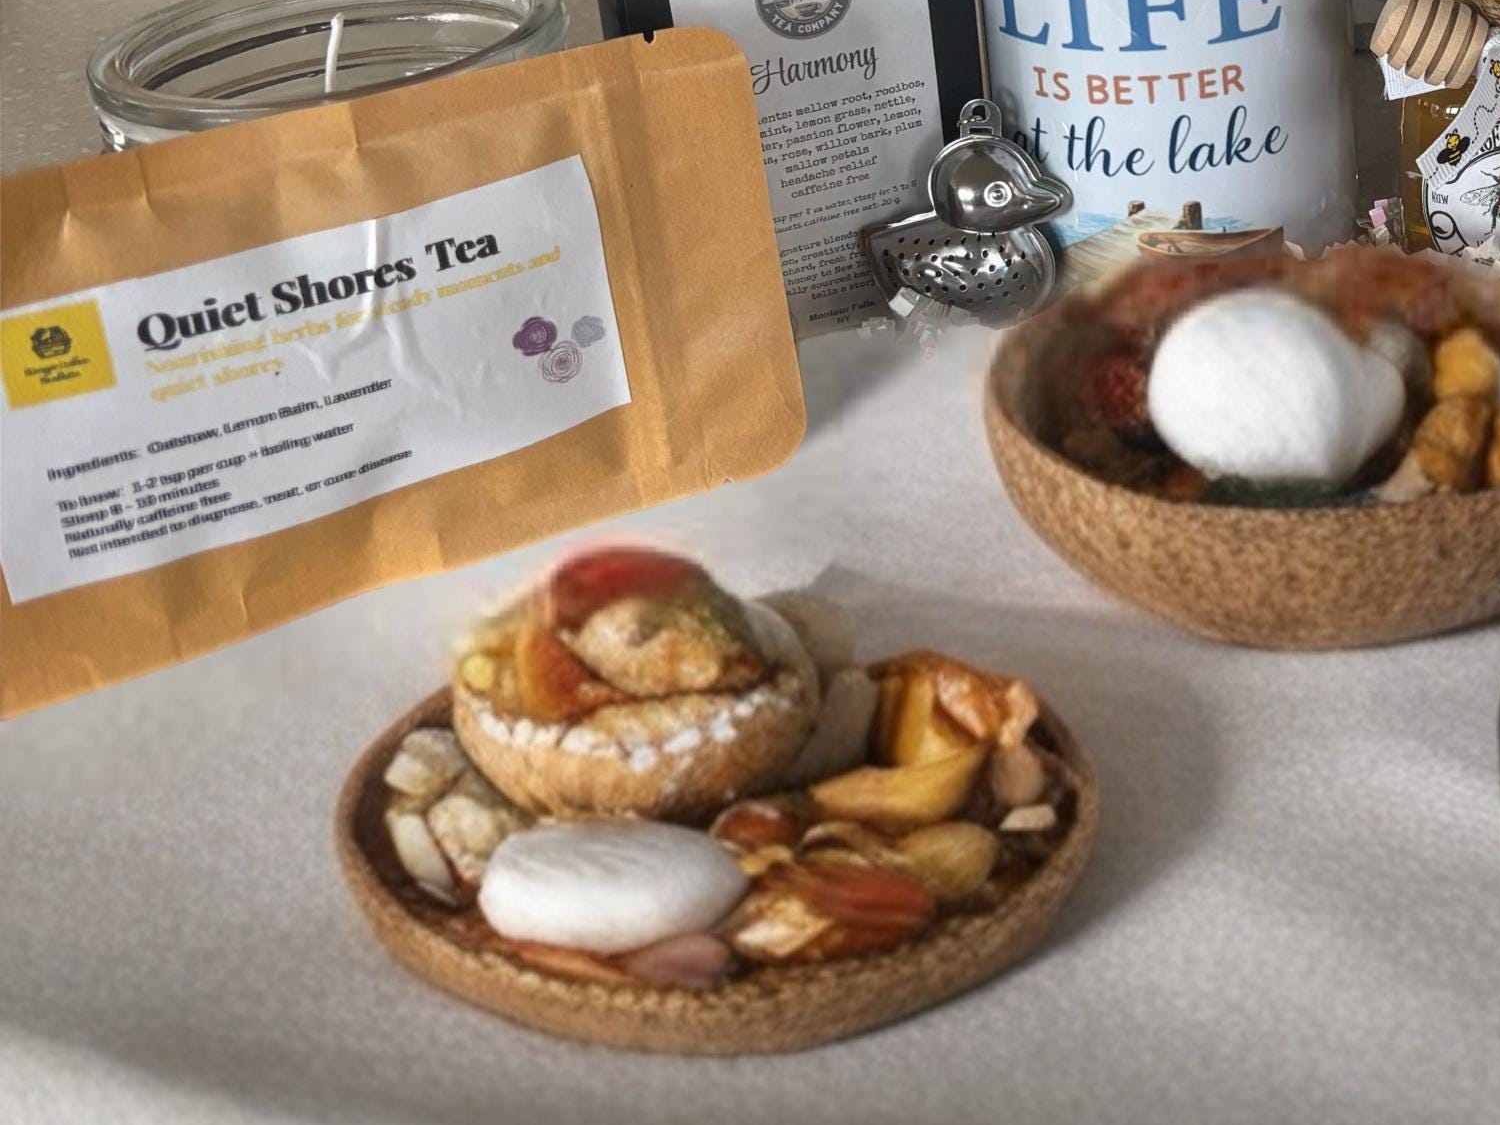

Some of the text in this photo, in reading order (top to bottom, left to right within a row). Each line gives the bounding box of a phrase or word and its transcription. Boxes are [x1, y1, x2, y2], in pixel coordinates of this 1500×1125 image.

[771, 2, 843, 34] TEA COMPANY
[749, 46, 879, 96] Harmony
[1032, 64, 1246, 105] IS BETTER
[795, 80, 925, 117] mellow root, rooibos,
[795, 115, 832, 131] lemon
[834, 106, 871, 123] grass,
[873, 95, 916, 112] nettle,
[780, 148, 813, 162] rose,
[815, 135, 858, 153] willow
[859, 127, 892, 141] bark,
[894, 119, 923, 135] plum
[785, 128, 834, 149] passion
[837, 117, 881, 135] flower,
[883, 107, 922, 123] lemon,
[1063, 115, 1155, 177] the
[1168, 105, 1289, 175] lake
[780, 155, 878, 189] headache relief
[784, 156, 828, 174] mallow
[830, 146, 870, 165] petals
[791, 173, 871, 199] caffeine free
[136, 234, 501, 352] Quiet Shores Tea
